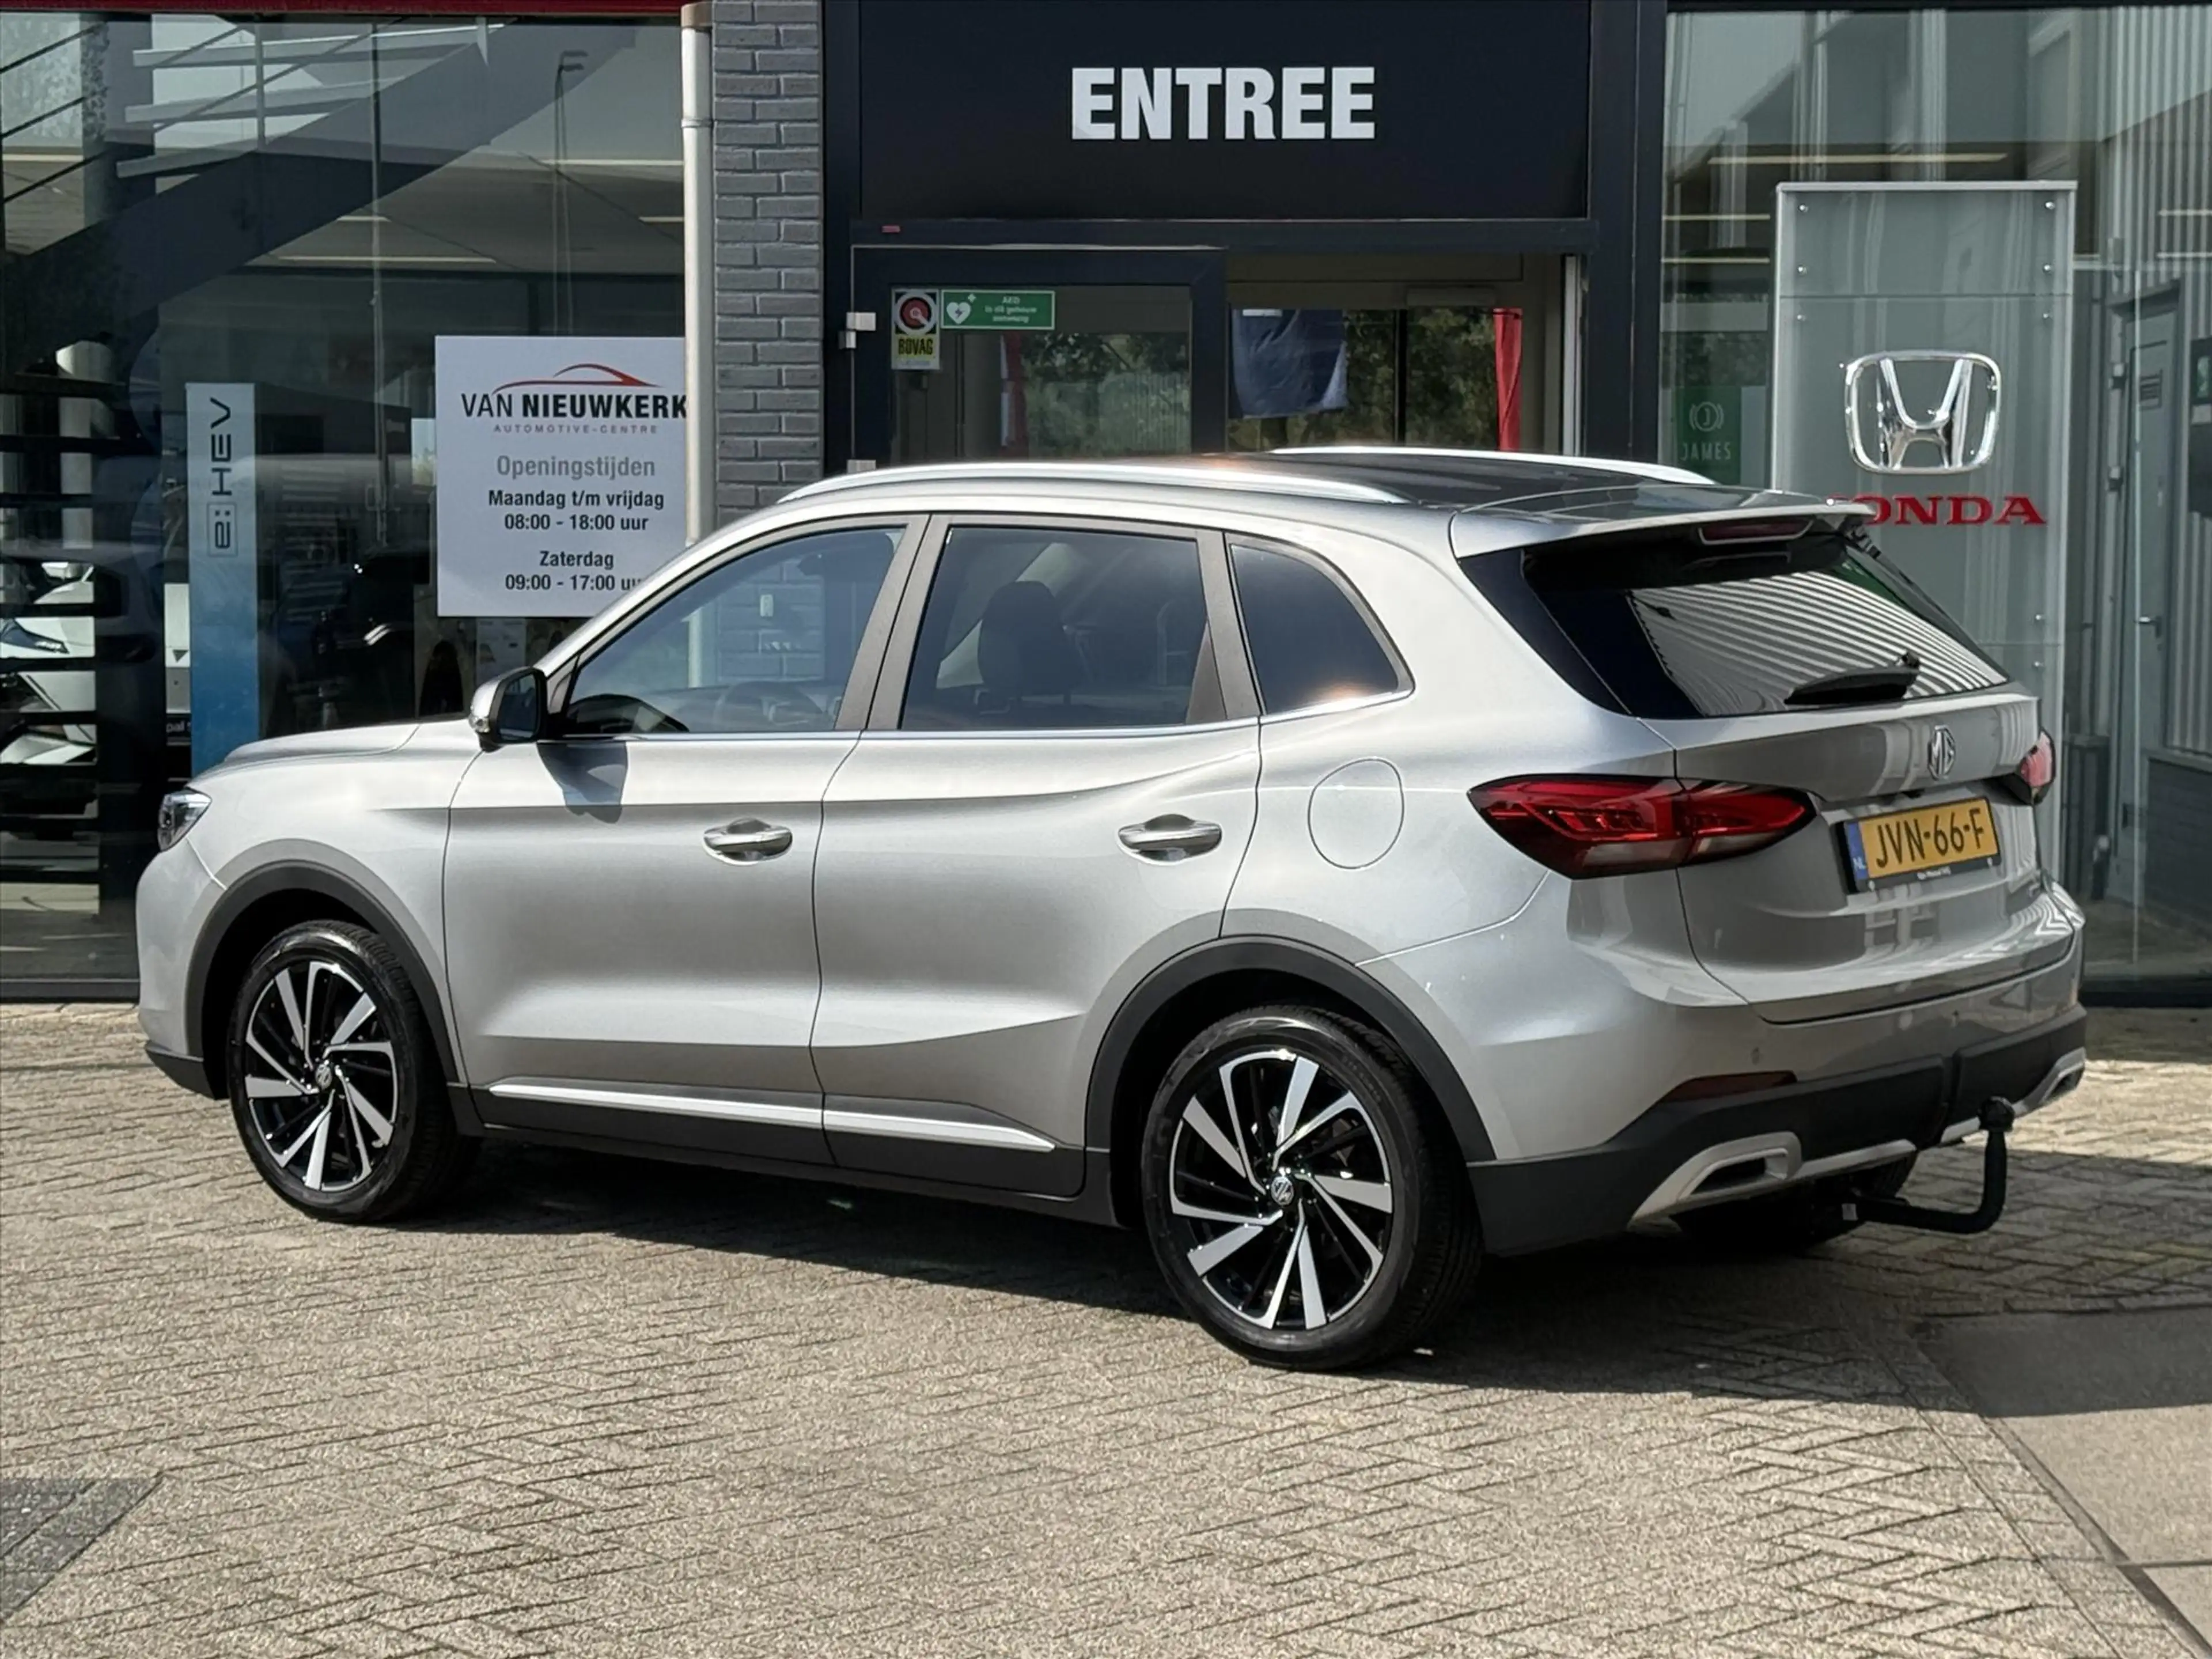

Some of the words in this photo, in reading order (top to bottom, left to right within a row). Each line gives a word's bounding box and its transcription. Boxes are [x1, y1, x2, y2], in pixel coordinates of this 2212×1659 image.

[1071, 66, 1376, 139] ENTREE
[898, 338, 933, 355] BOVAG
[461, 393, 513, 418] VAN
[522, 394, 687, 419] NIEUWKERK
[493, 424, 658, 434] AUTOMOTIVE-CENTRE
[1680, 442, 1732, 461] JAMES
[497, 455, 656, 480] Openingstijden
[488, 490, 566, 509] Maandag
[571, 490, 600, 507] t/m
[606, 490, 665, 510] vrijdag
[1827, 494, 2047, 525] ONDA
[504, 514, 551, 529] 08:00
[570, 514, 615, 530] 18:00
[620, 517, 649, 530] uur
[539, 551, 615, 570] Zaterdag
[505, 574, 551, 590] 09:00
[571, 575, 615, 590] 17:00
[1876, 809, 1983, 869] JVN-66-F
